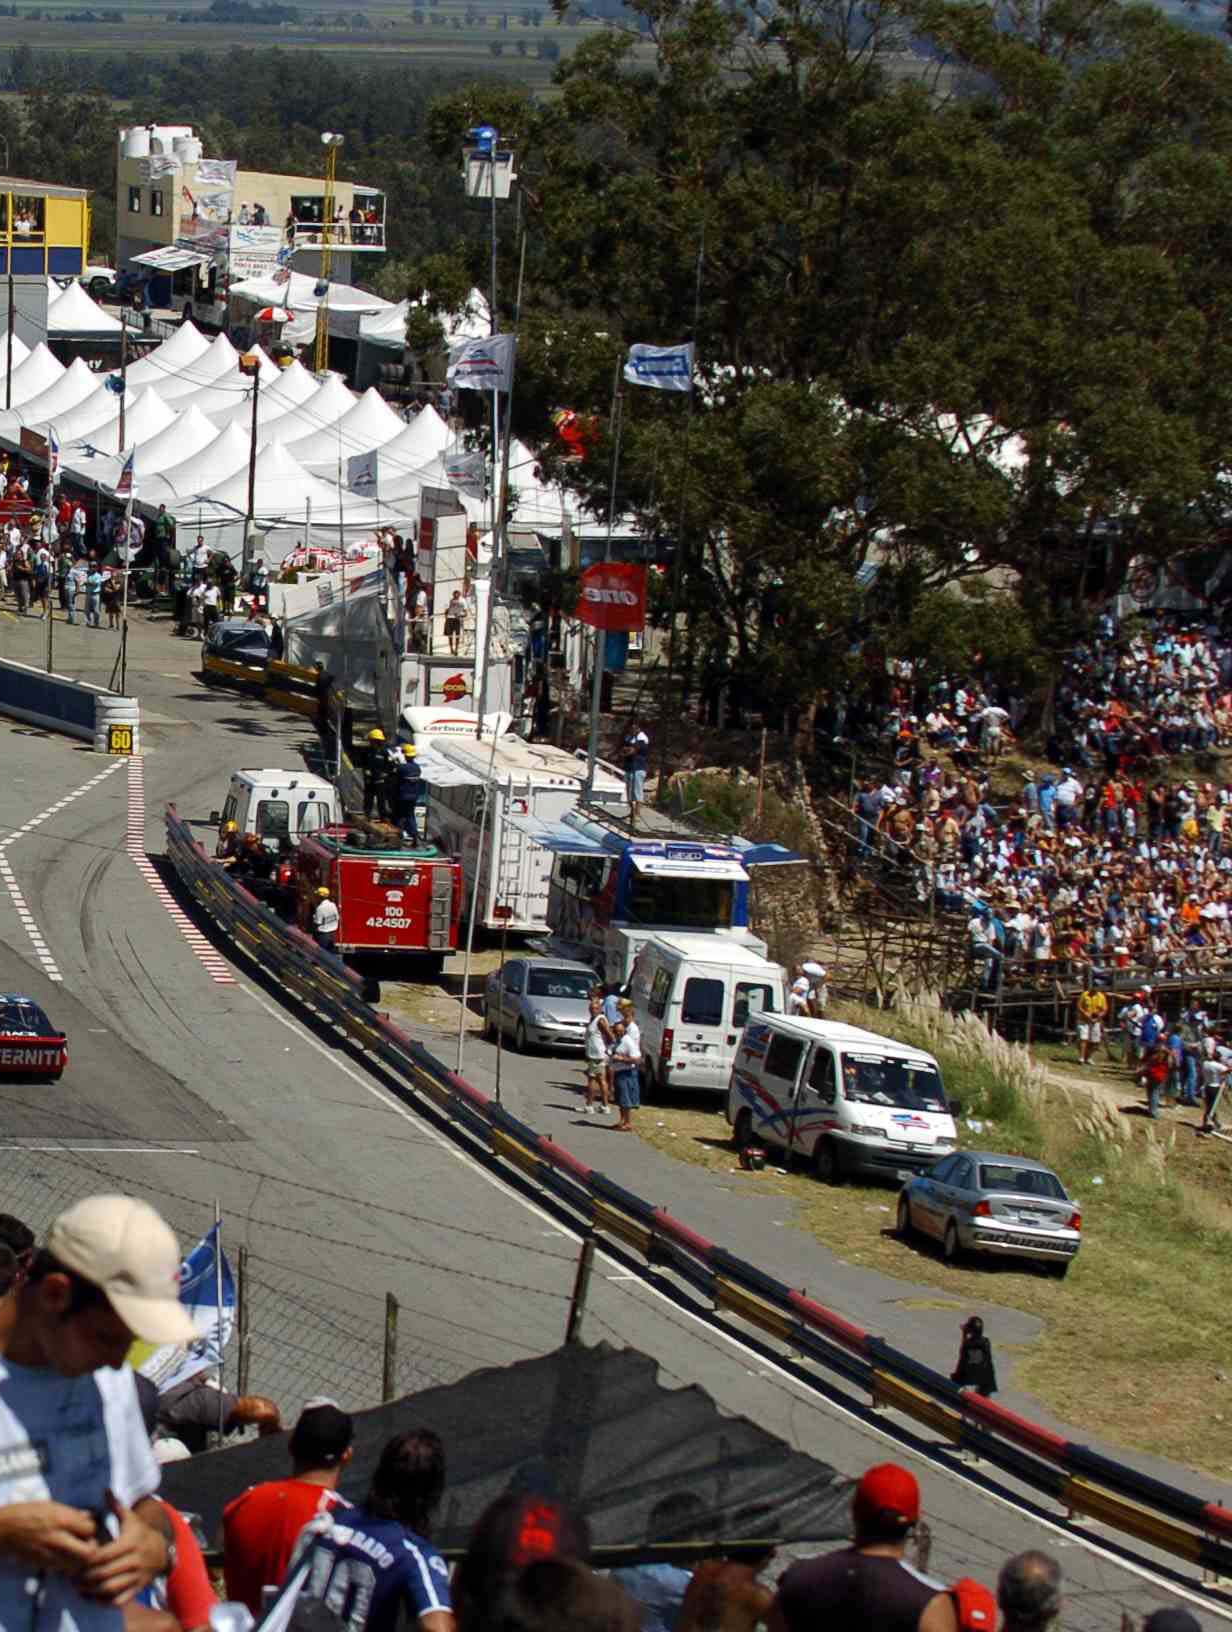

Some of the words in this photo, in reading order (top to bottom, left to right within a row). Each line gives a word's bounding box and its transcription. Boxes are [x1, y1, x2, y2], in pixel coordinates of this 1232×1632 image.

[112, 730, 131, 749] 60
[384, 906, 404, 917] 100
[366, 917, 413, 928] 424507
